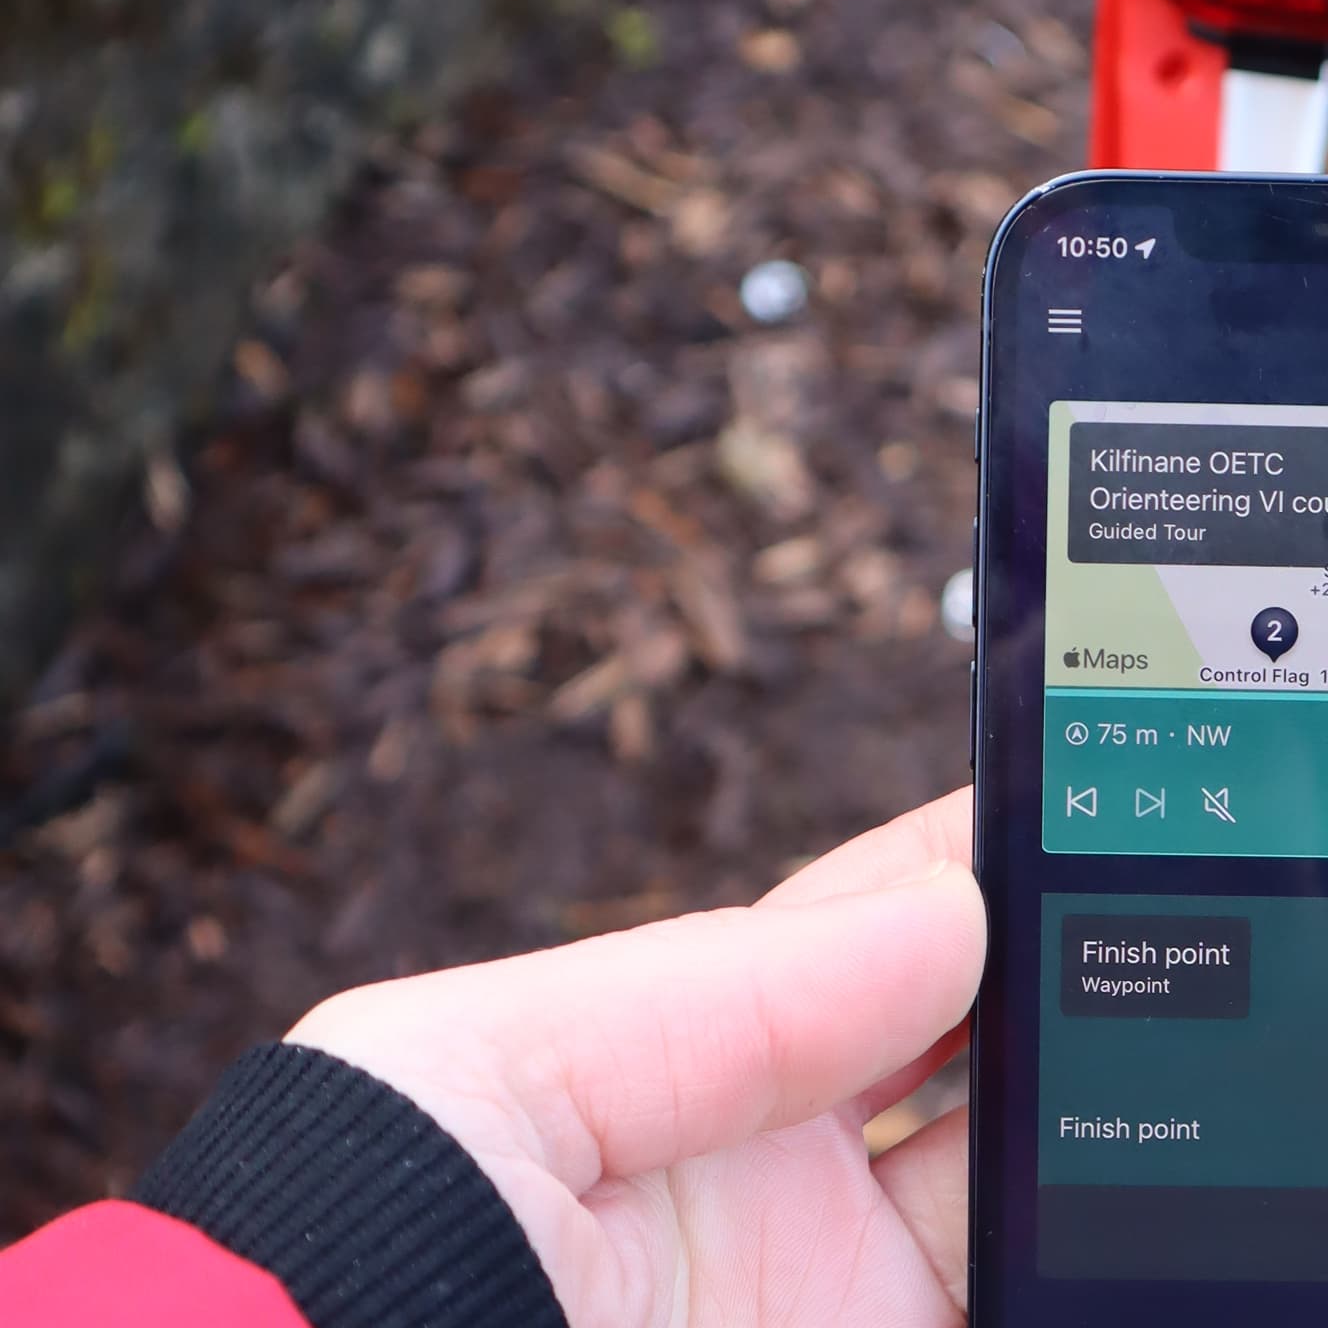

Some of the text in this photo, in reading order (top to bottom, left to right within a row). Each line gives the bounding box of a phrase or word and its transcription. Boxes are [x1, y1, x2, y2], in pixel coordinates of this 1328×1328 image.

[1057, 236, 1128, 258] 10:50
[1090, 449, 1284, 475] Kilfinane OETC
[1089, 486, 1251, 517] Orienteering
[1258, 490, 1285, 513] VI
[1088, 522, 1207, 541] Guided Tour
[1266, 620, 1283, 642] 2
[1083, 648, 1149, 673] Maps
[1199, 667, 1266, 683] Control
[1272, 669, 1310, 686] Flag
[1097, 723, 1231, 747] 75 m NW
[1082, 940, 1231, 969] Finish point
[1081, 976, 1170, 997] Waypoint
[1060, 1117, 1200, 1144] Finish point
